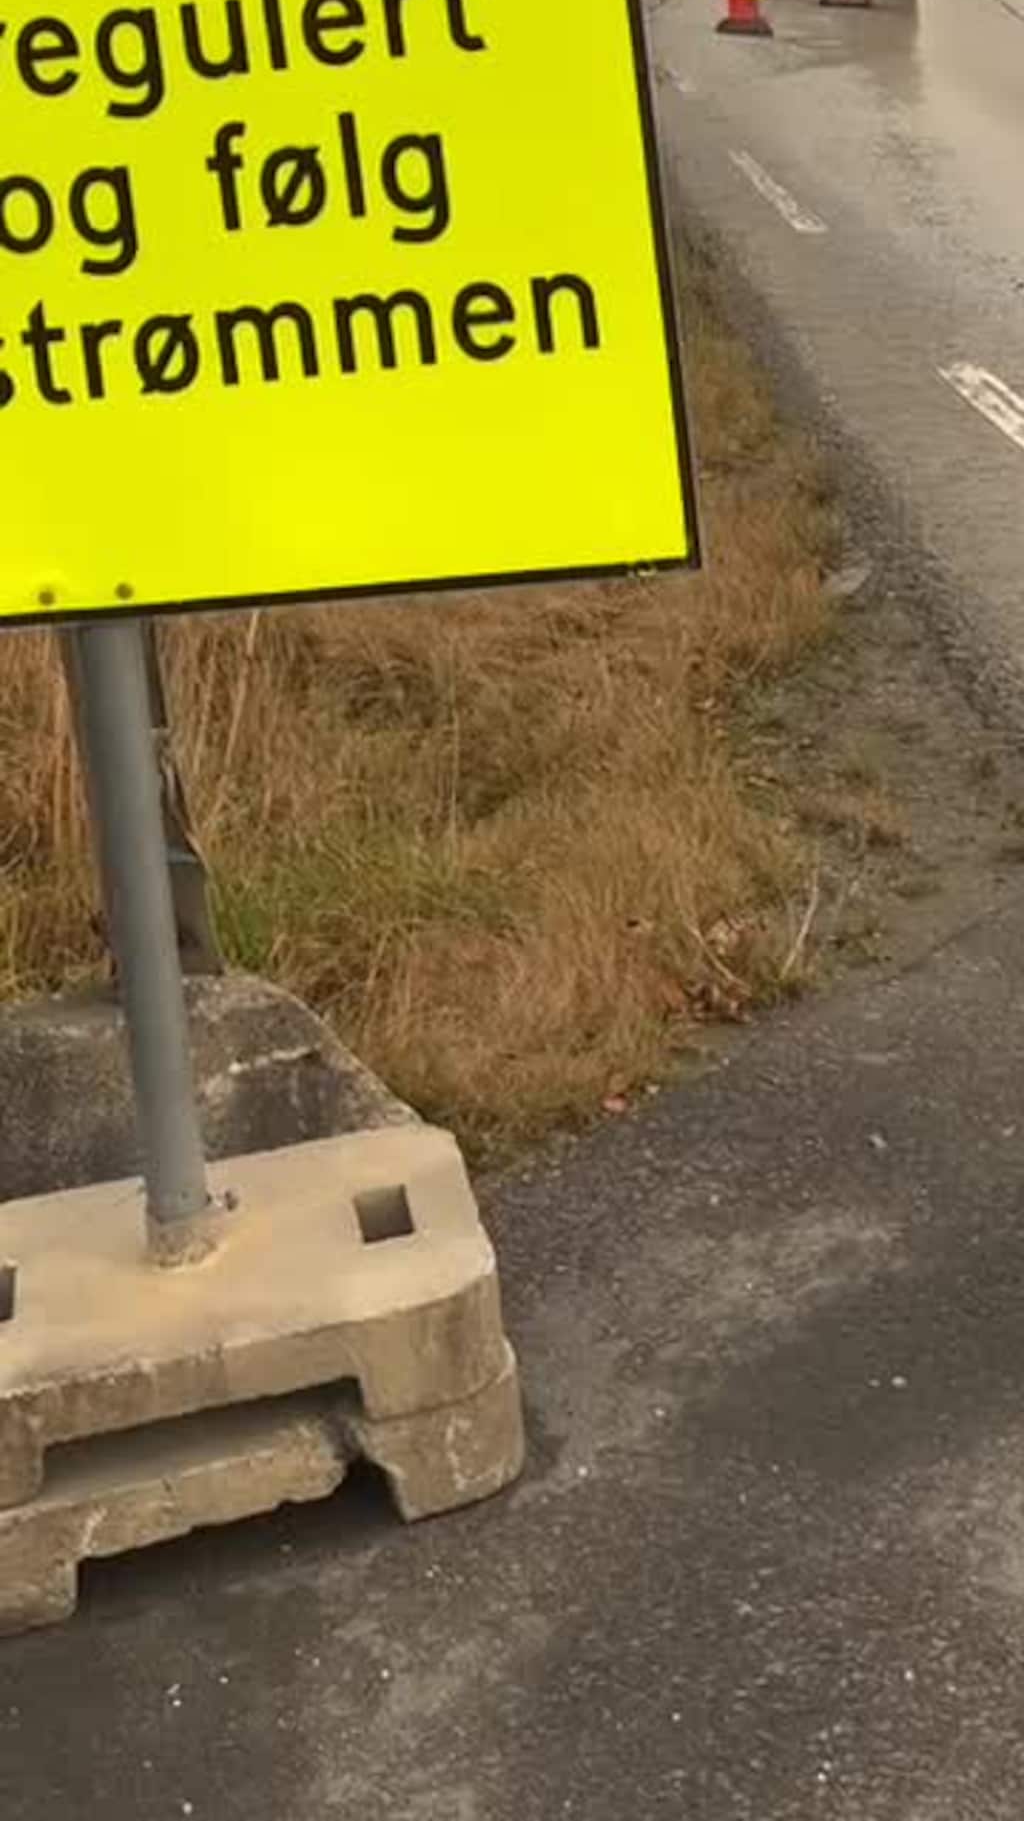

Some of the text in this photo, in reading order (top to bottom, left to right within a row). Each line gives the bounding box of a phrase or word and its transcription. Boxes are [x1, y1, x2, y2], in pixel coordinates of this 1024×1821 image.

[0, 111, 451, 277] og følg
[0, 273, 601, 408] trømmen
